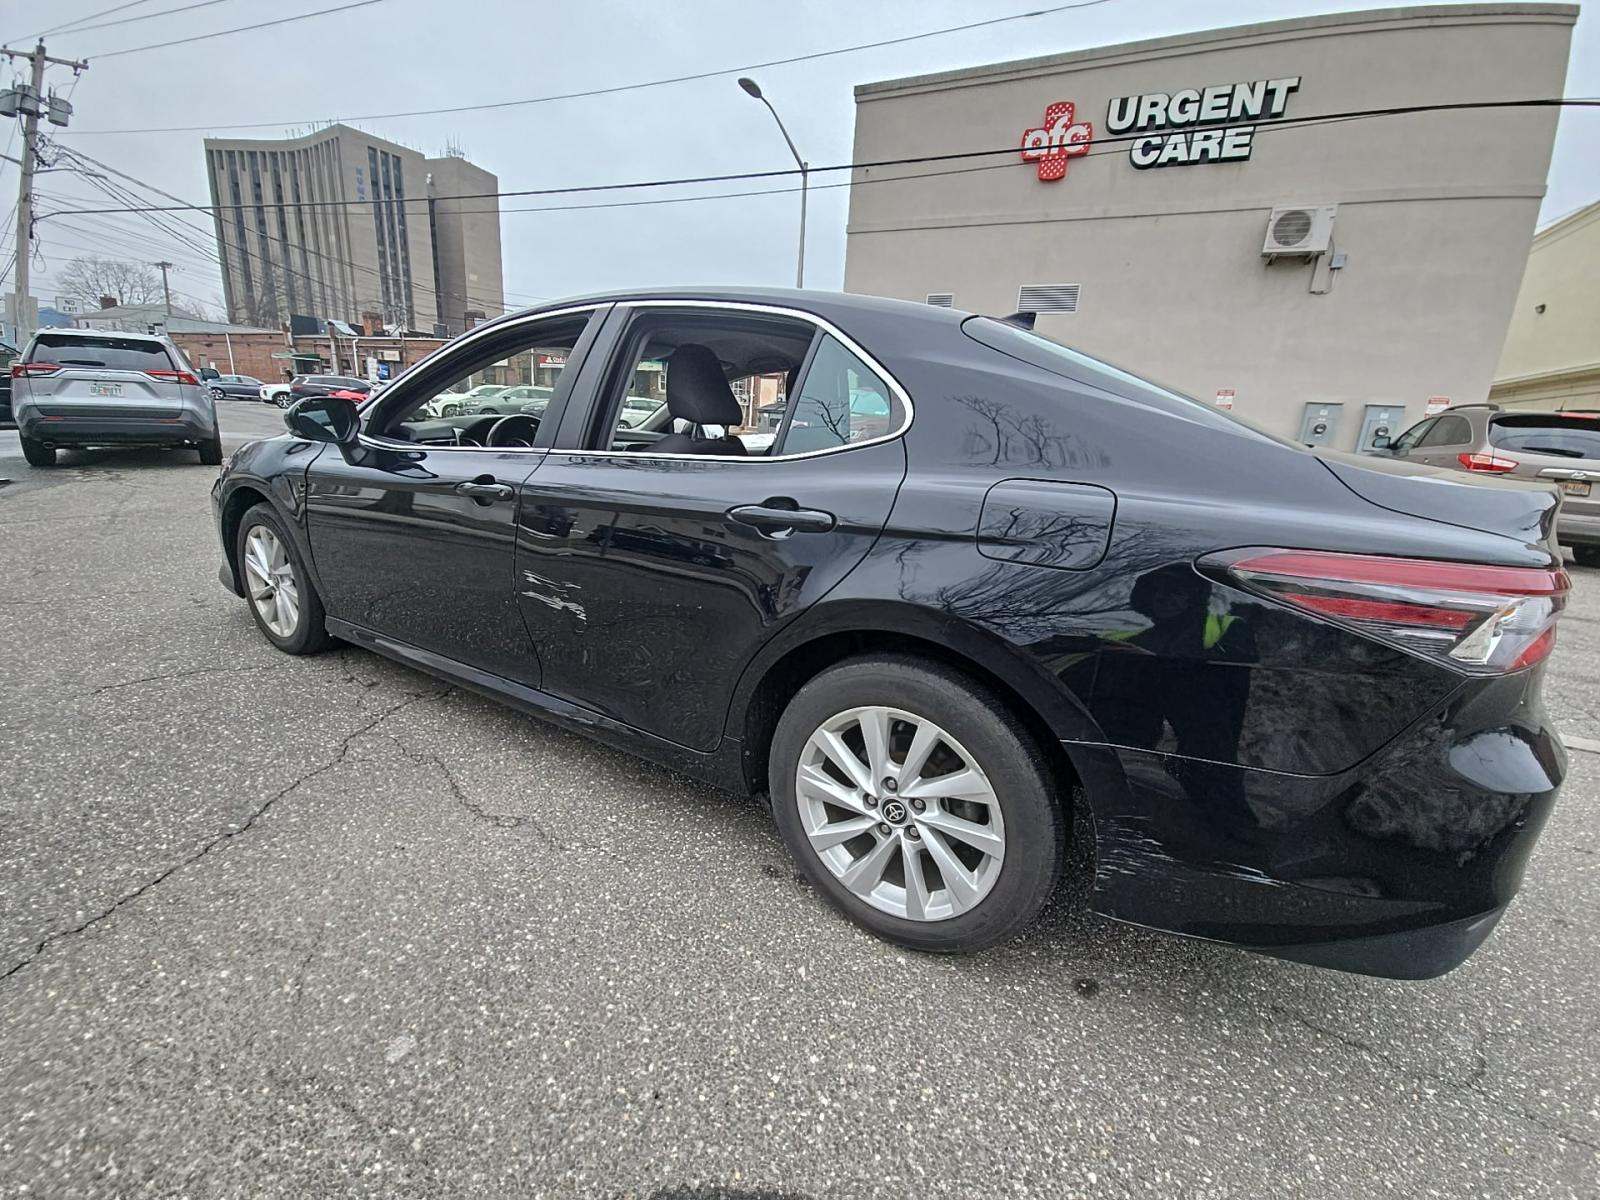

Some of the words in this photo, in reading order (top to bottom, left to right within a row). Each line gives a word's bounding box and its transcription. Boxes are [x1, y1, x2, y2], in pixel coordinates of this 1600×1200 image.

[1106, 76, 1301, 134] URGENT
[1024, 115, 1089, 156] afc
[1129, 126, 1256, 170] CARE
